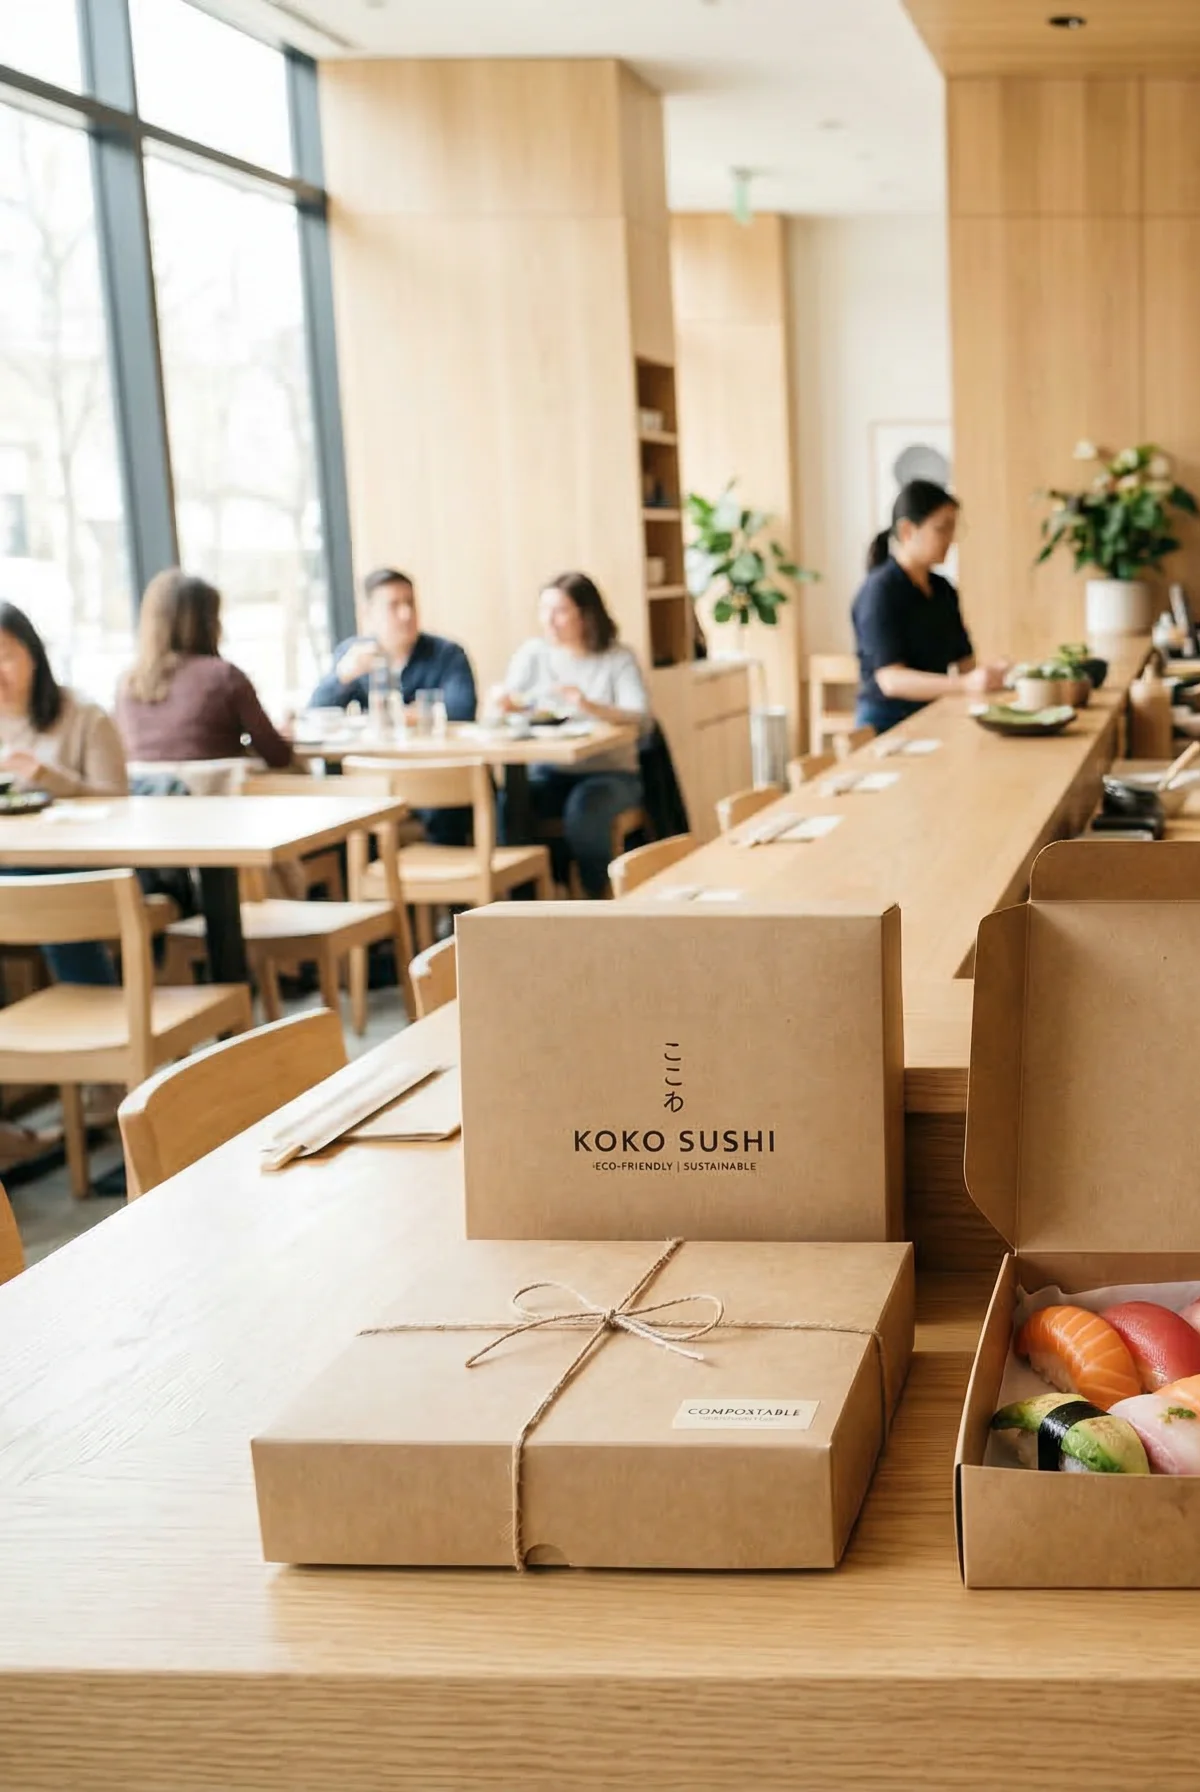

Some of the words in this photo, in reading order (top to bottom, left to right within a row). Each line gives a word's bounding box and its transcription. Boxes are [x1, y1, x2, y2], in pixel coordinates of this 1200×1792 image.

[574, 1129, 665, 1153] KOKO
[679, 1129, 775, 1153] SUSHI
[683, 1161, 757, 1171] SUSTAINABLE
